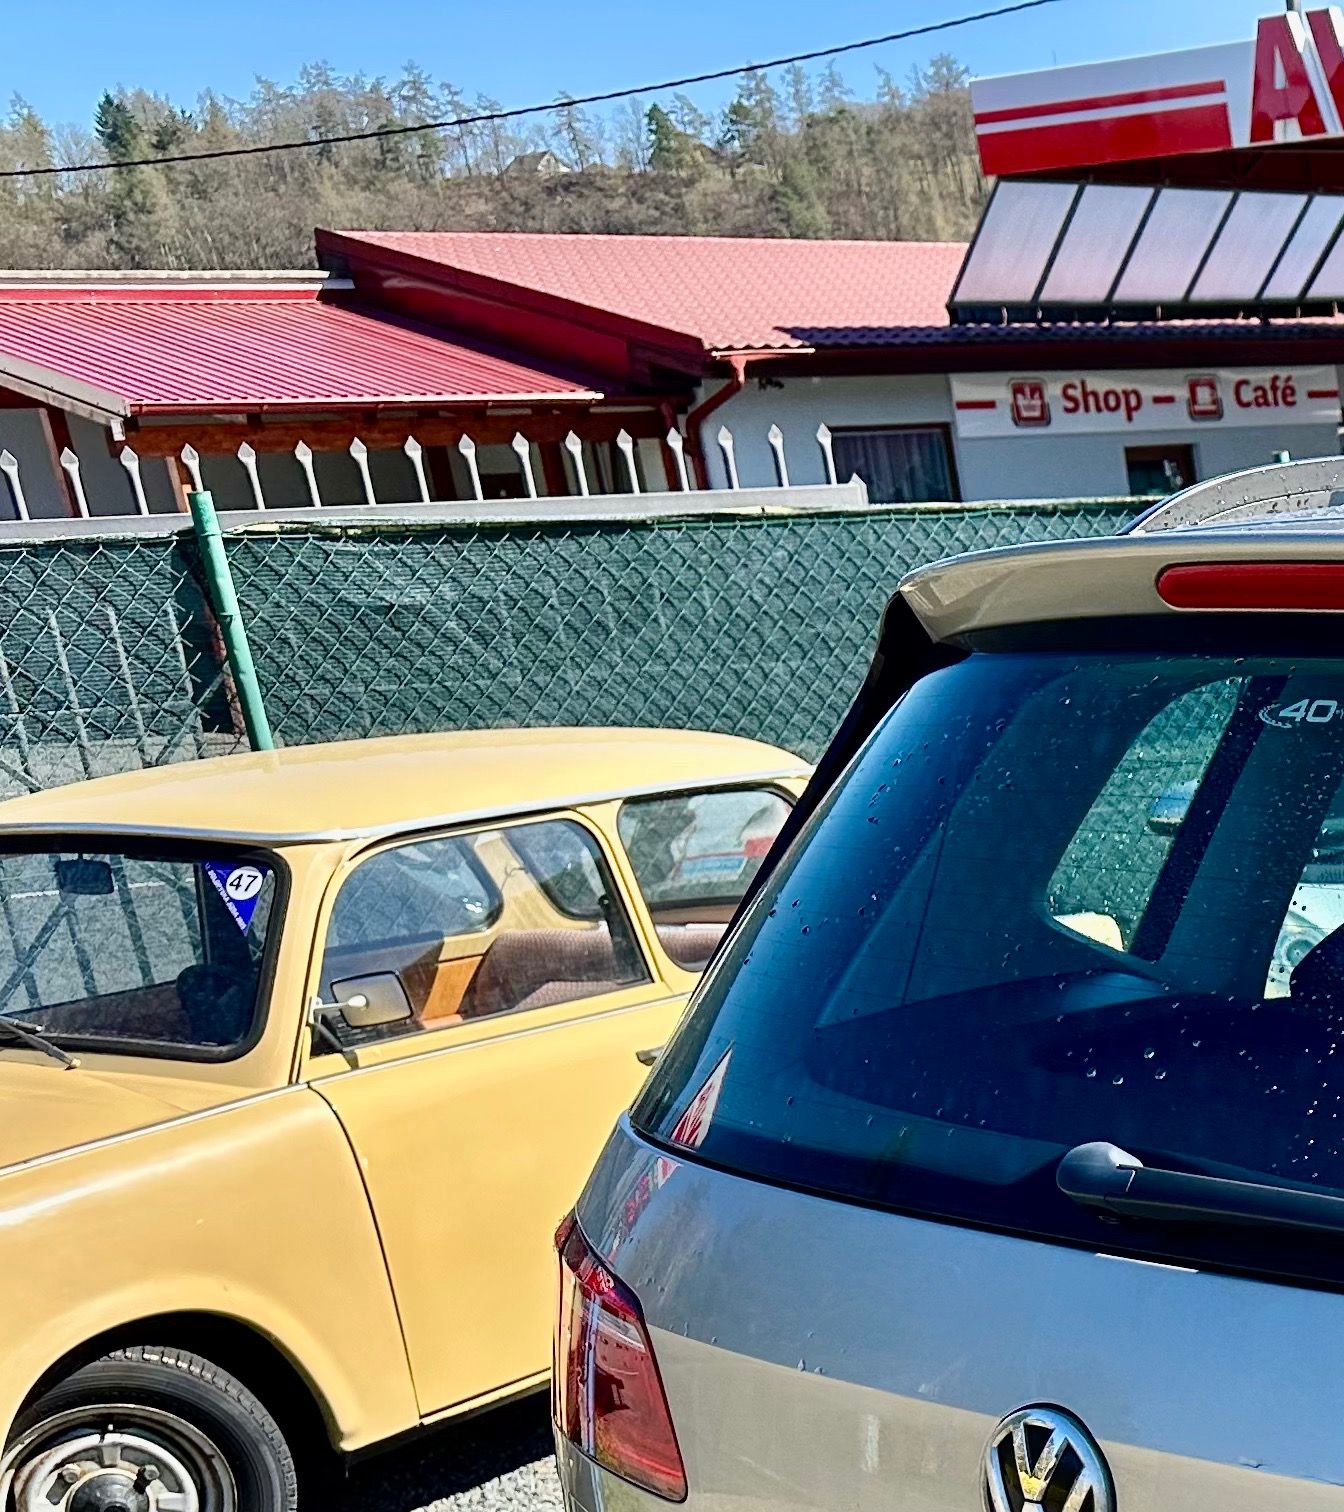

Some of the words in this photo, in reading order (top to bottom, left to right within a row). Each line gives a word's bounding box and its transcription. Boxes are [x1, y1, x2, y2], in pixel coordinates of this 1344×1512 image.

[1062, 380, 1143, 422] Shop
[1233, 375, 1297, 409] Café
[1279, 699, 1338, 723] 40
[229, 873, 259, 892] 47
